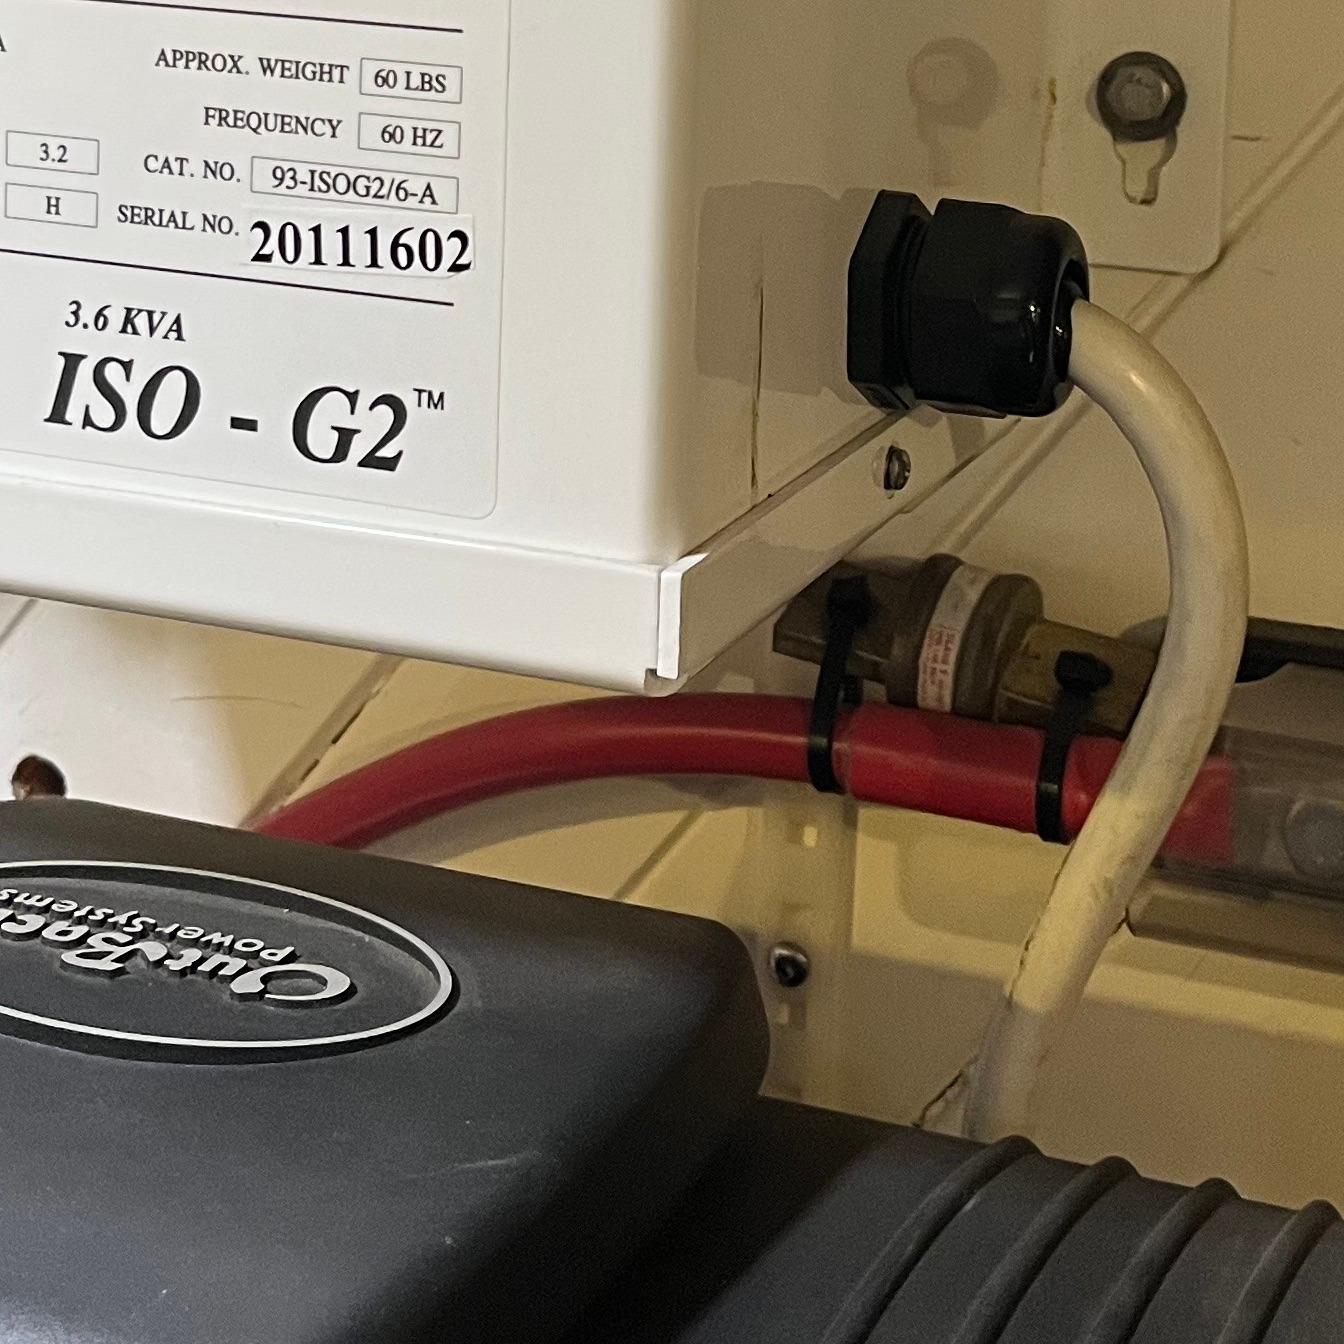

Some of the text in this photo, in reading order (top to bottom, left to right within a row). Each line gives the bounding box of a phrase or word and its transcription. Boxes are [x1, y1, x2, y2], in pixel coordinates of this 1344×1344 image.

[154, 47, 447, 94] APPROX. WEIGHT 60 LBS
[202, 105, 445, 150] FREQUENCY 60 HZ
[38, 142, 69, 164] 3.2
[143, 153, 439, 206] CAT. NO. 93-ISOG2/6-A
[45, 195, 62, 217] H
[116, 203, 472, 273] SERIAL NO. 20111602
[64, 299, 187, 343] 3.6 KVA
[44, 351, 201, 441] ISO
[229, 415, 259, 433] -
